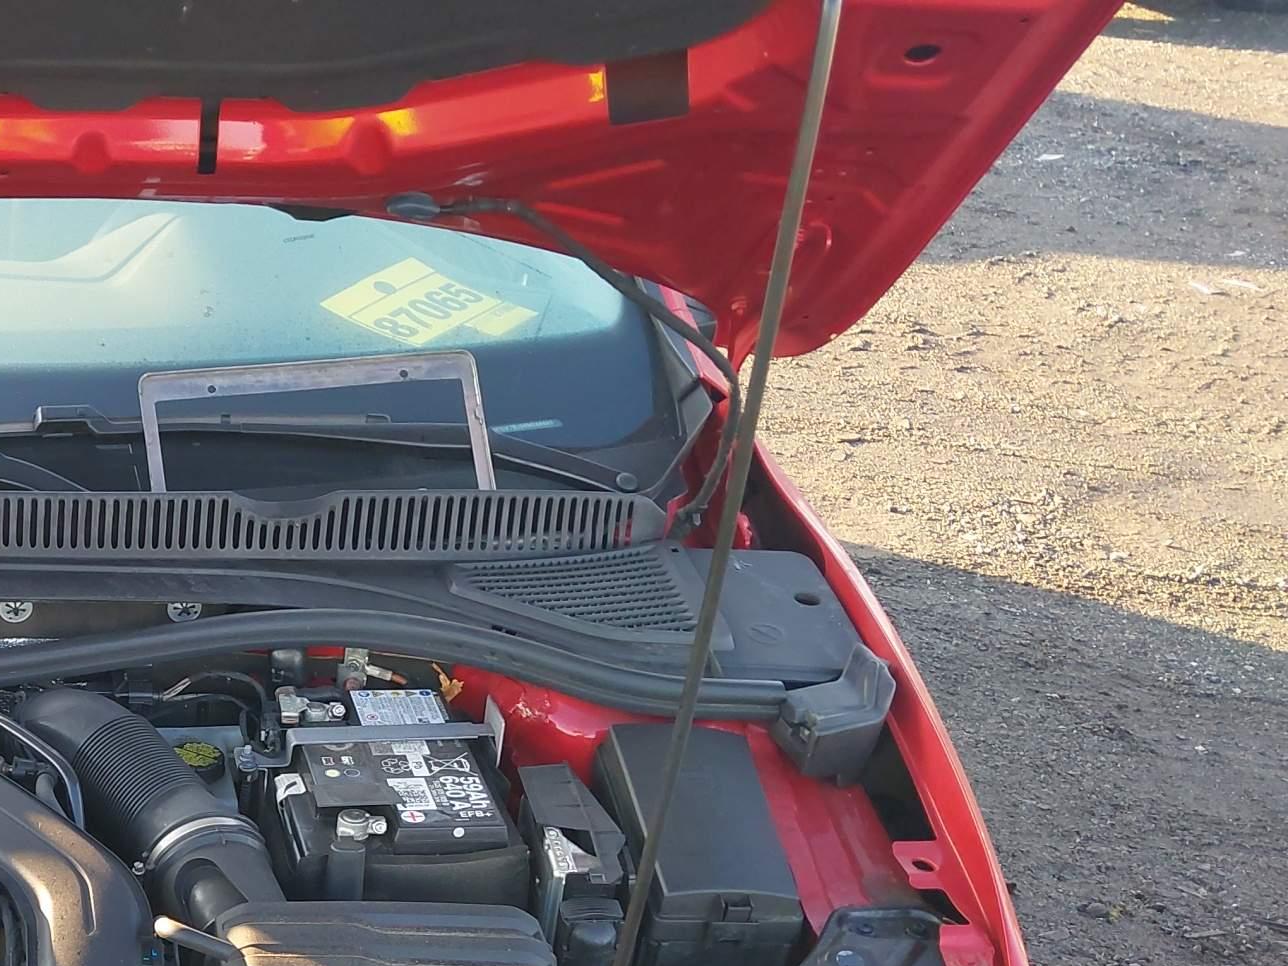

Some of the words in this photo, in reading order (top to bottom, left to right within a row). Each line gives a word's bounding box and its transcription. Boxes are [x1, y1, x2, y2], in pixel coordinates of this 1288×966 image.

[373, 282, 485, 339] 87065
[439, 775, 466, 798] 640
[460, 776, 491, 809] 59Ah
[459, 810, 493, 818] EFB+
